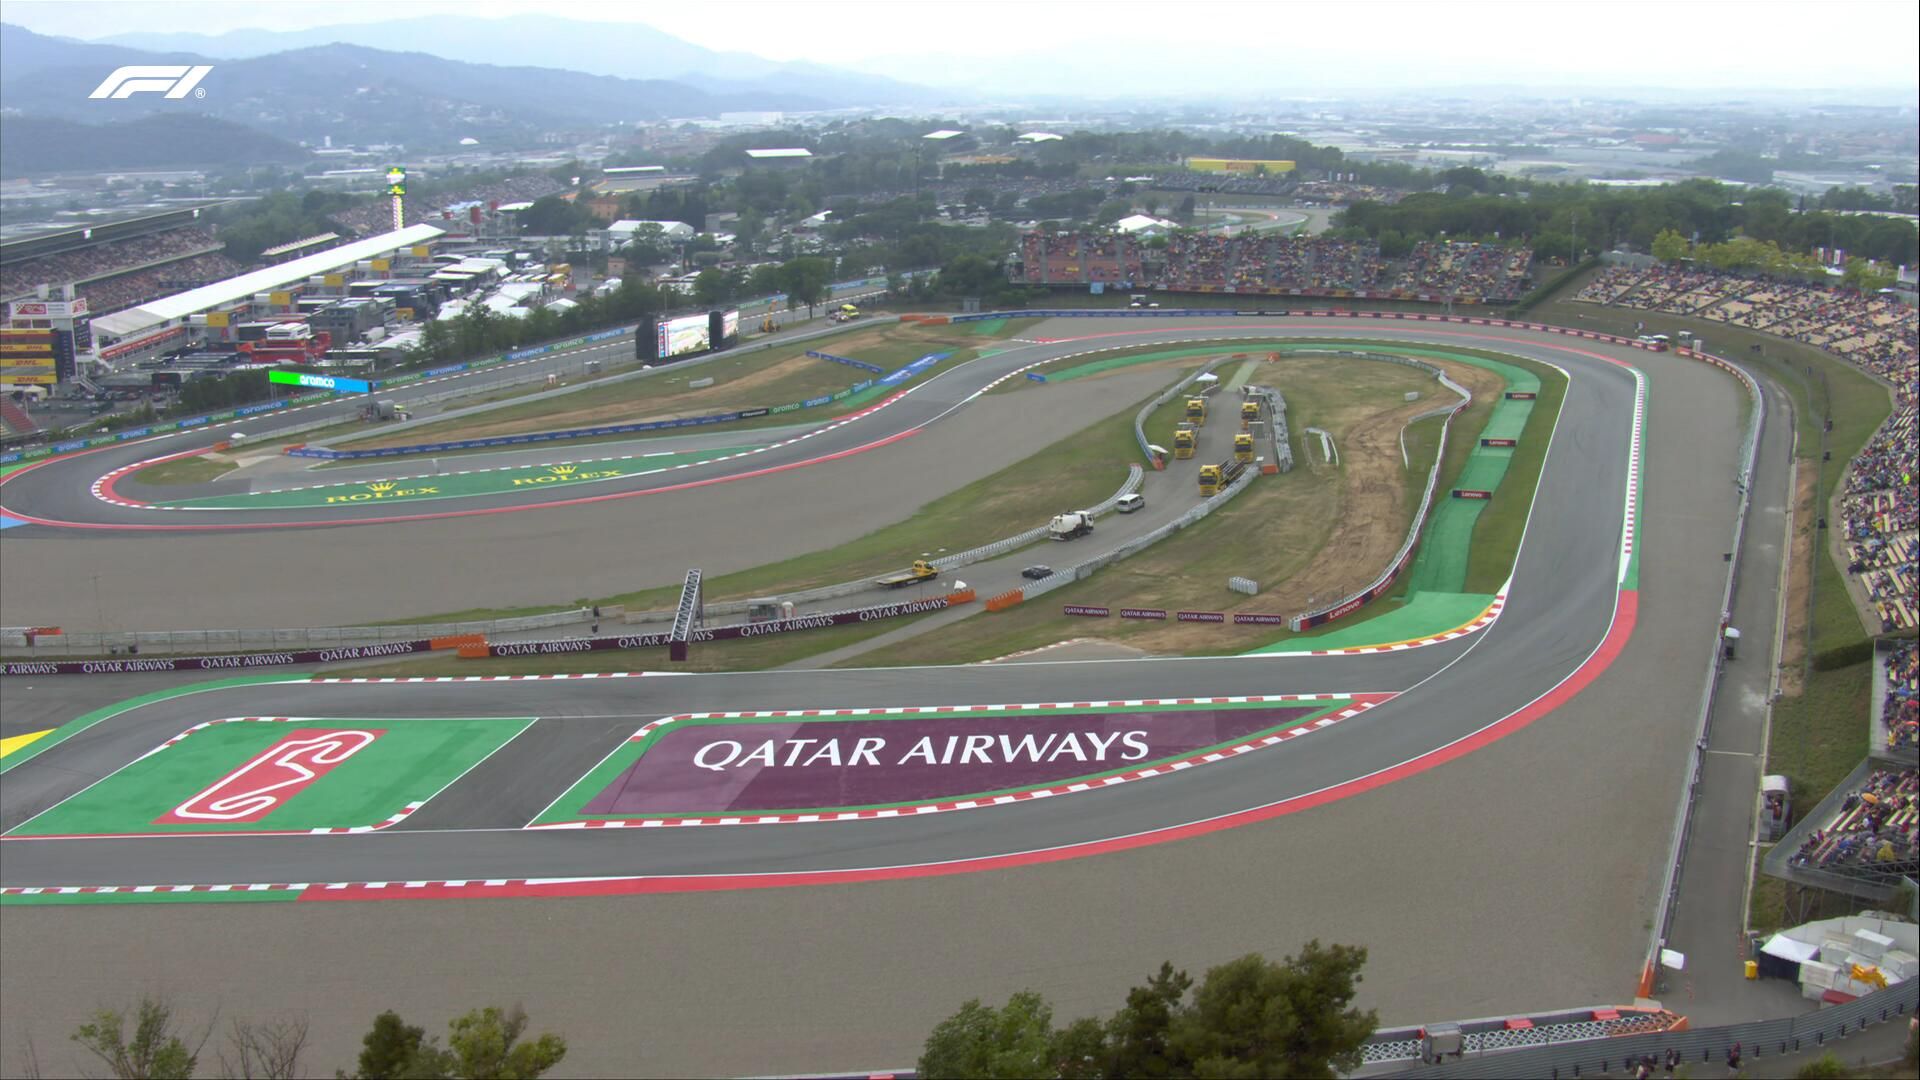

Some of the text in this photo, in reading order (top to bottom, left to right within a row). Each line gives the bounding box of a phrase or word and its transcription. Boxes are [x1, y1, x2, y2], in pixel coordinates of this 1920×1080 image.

[300, 374, 335, 388] aramco
[773, 402, 799, 413] aramco
[511, 470, 622, 486] ROLEX
[325, 486, 440, 503] ROLEX
[859, 599, 948, 621] QATAR AIRWAYS
[1329, 600, 1361, 620] Lenovo
[741, 616, 833, 637] QATAR AIRWAYS
[497, 641, 591, 656] QATAR AIRWAYS
[618, 637, 658, 648] QATAR
[320, 643, 412, 662] QATAR AIRWAYS
[9, 664, 58, 674] AIRWAYS
[83, 660, 175, 673] QATAR AIRWAYS
[201, 654, 294, 669] QATAR AIRWAYS
[693, 730, 1149, 772] QATAR AIRWAYS
